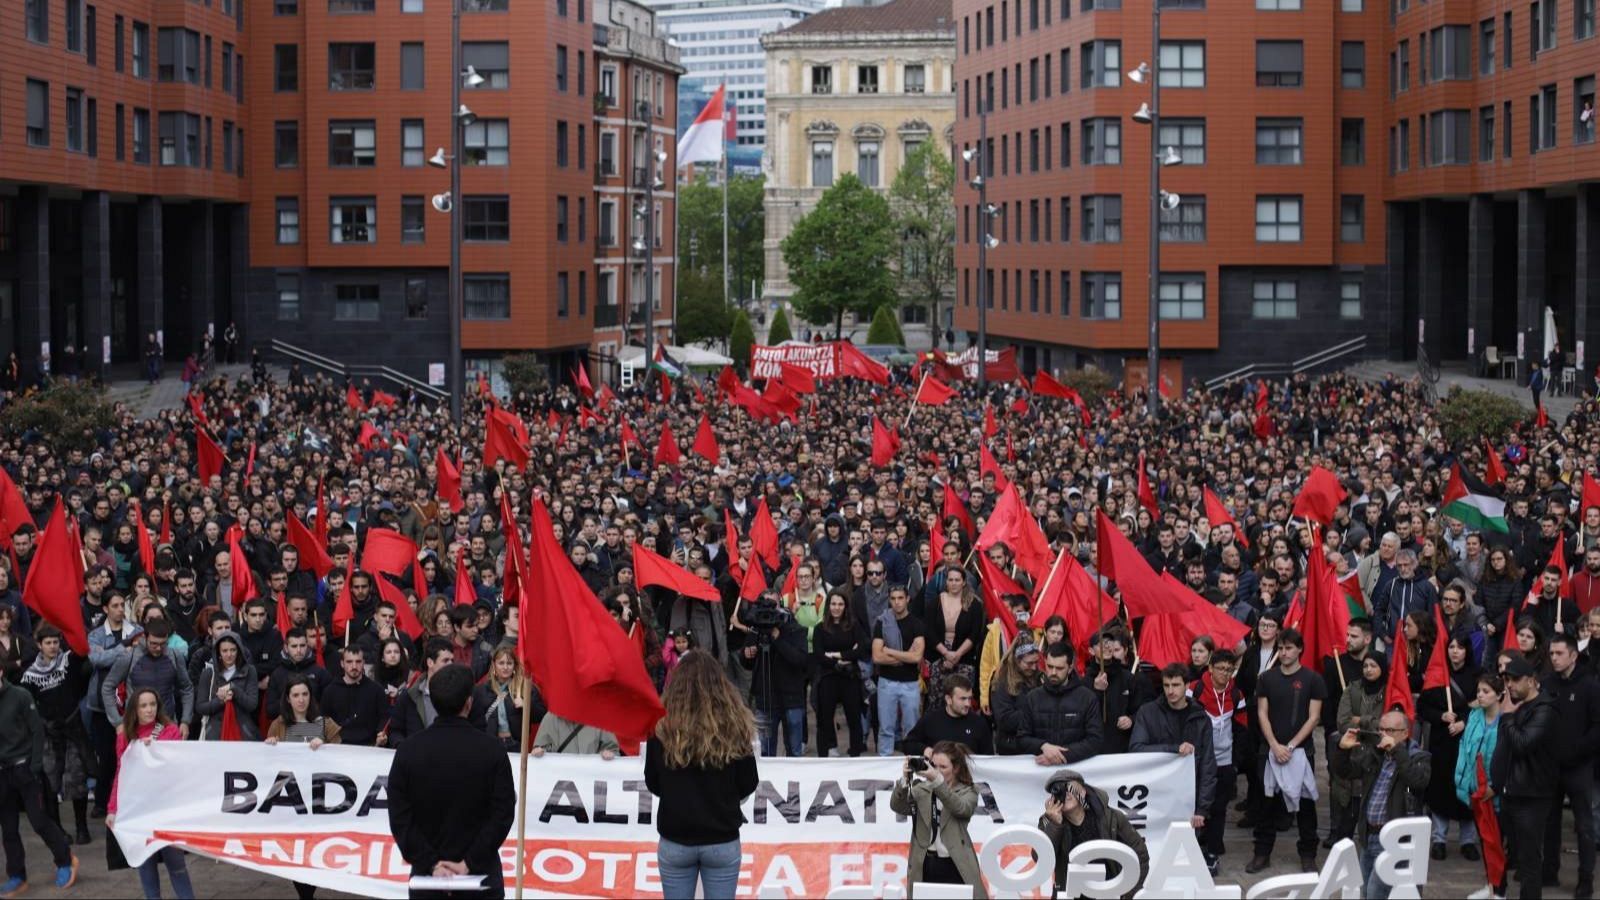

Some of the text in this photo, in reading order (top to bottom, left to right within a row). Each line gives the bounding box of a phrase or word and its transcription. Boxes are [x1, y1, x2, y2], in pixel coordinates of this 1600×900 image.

[752, 345, 834, 362] ANTOLAKUNTZA
[752, 359, 834, 377] KOMSTA
[538, 779, 1005, 825] ALTNATA
